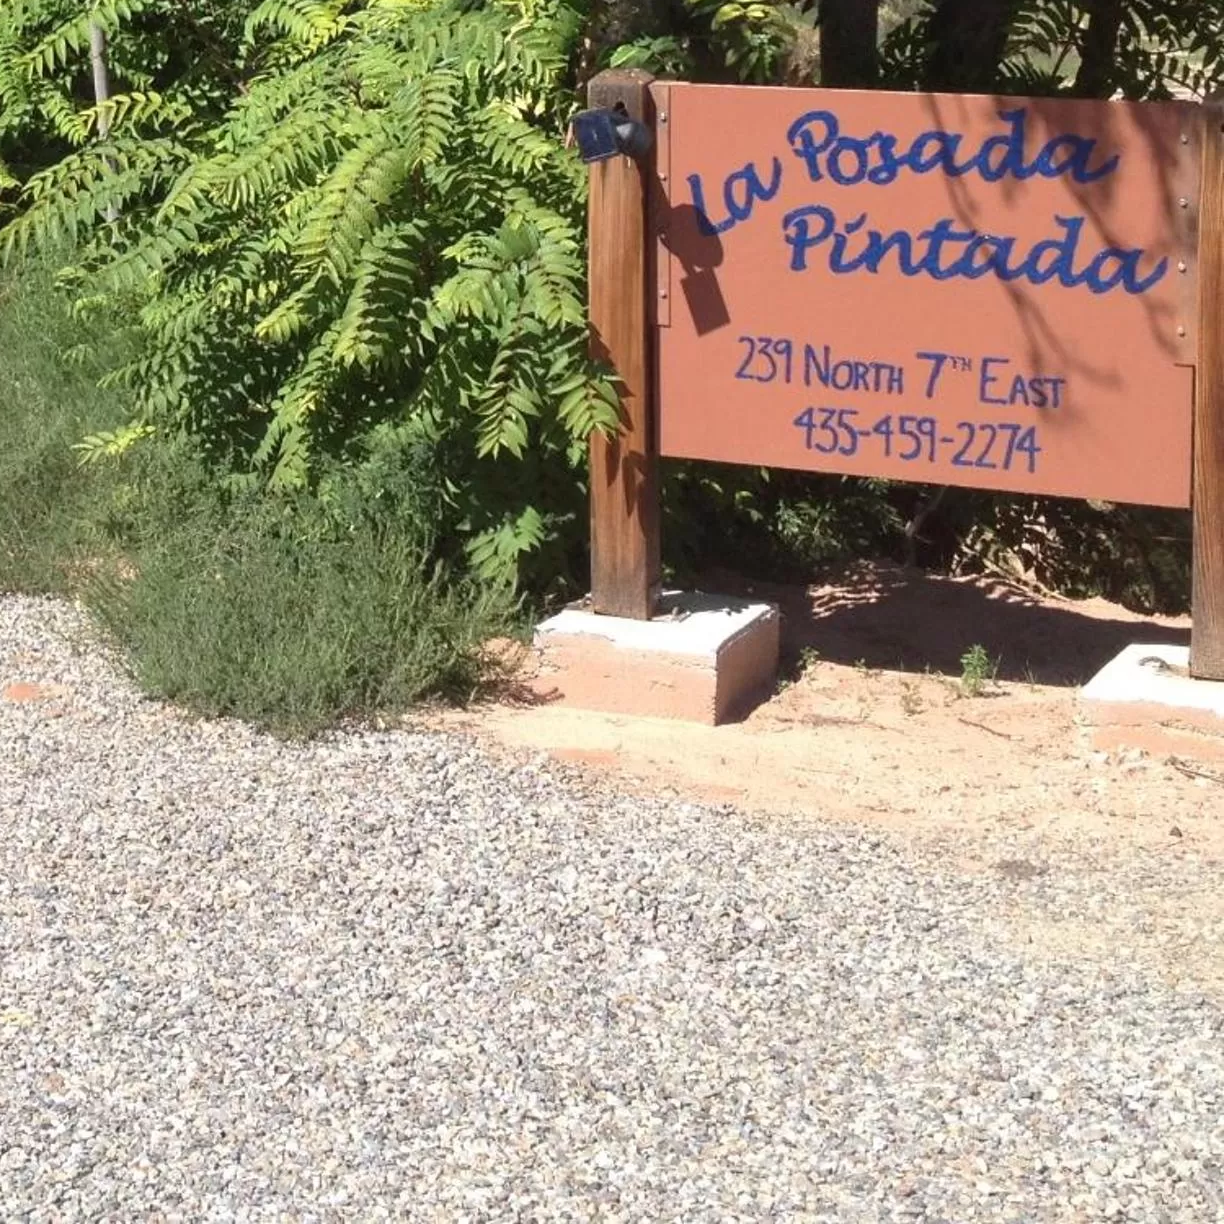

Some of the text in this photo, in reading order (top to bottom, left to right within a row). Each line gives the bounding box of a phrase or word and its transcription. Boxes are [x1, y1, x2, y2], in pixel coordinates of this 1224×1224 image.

[687, 109, 1120, 236] La Posada
[783, 205, 1168, 294] Pintada
[735, 337, 792, 384] 239
[804, 345, 903, 396] NORTH
[980, 358, 1066, 408] EAST
[793, 407, 1041, 474] 435-459-2274
